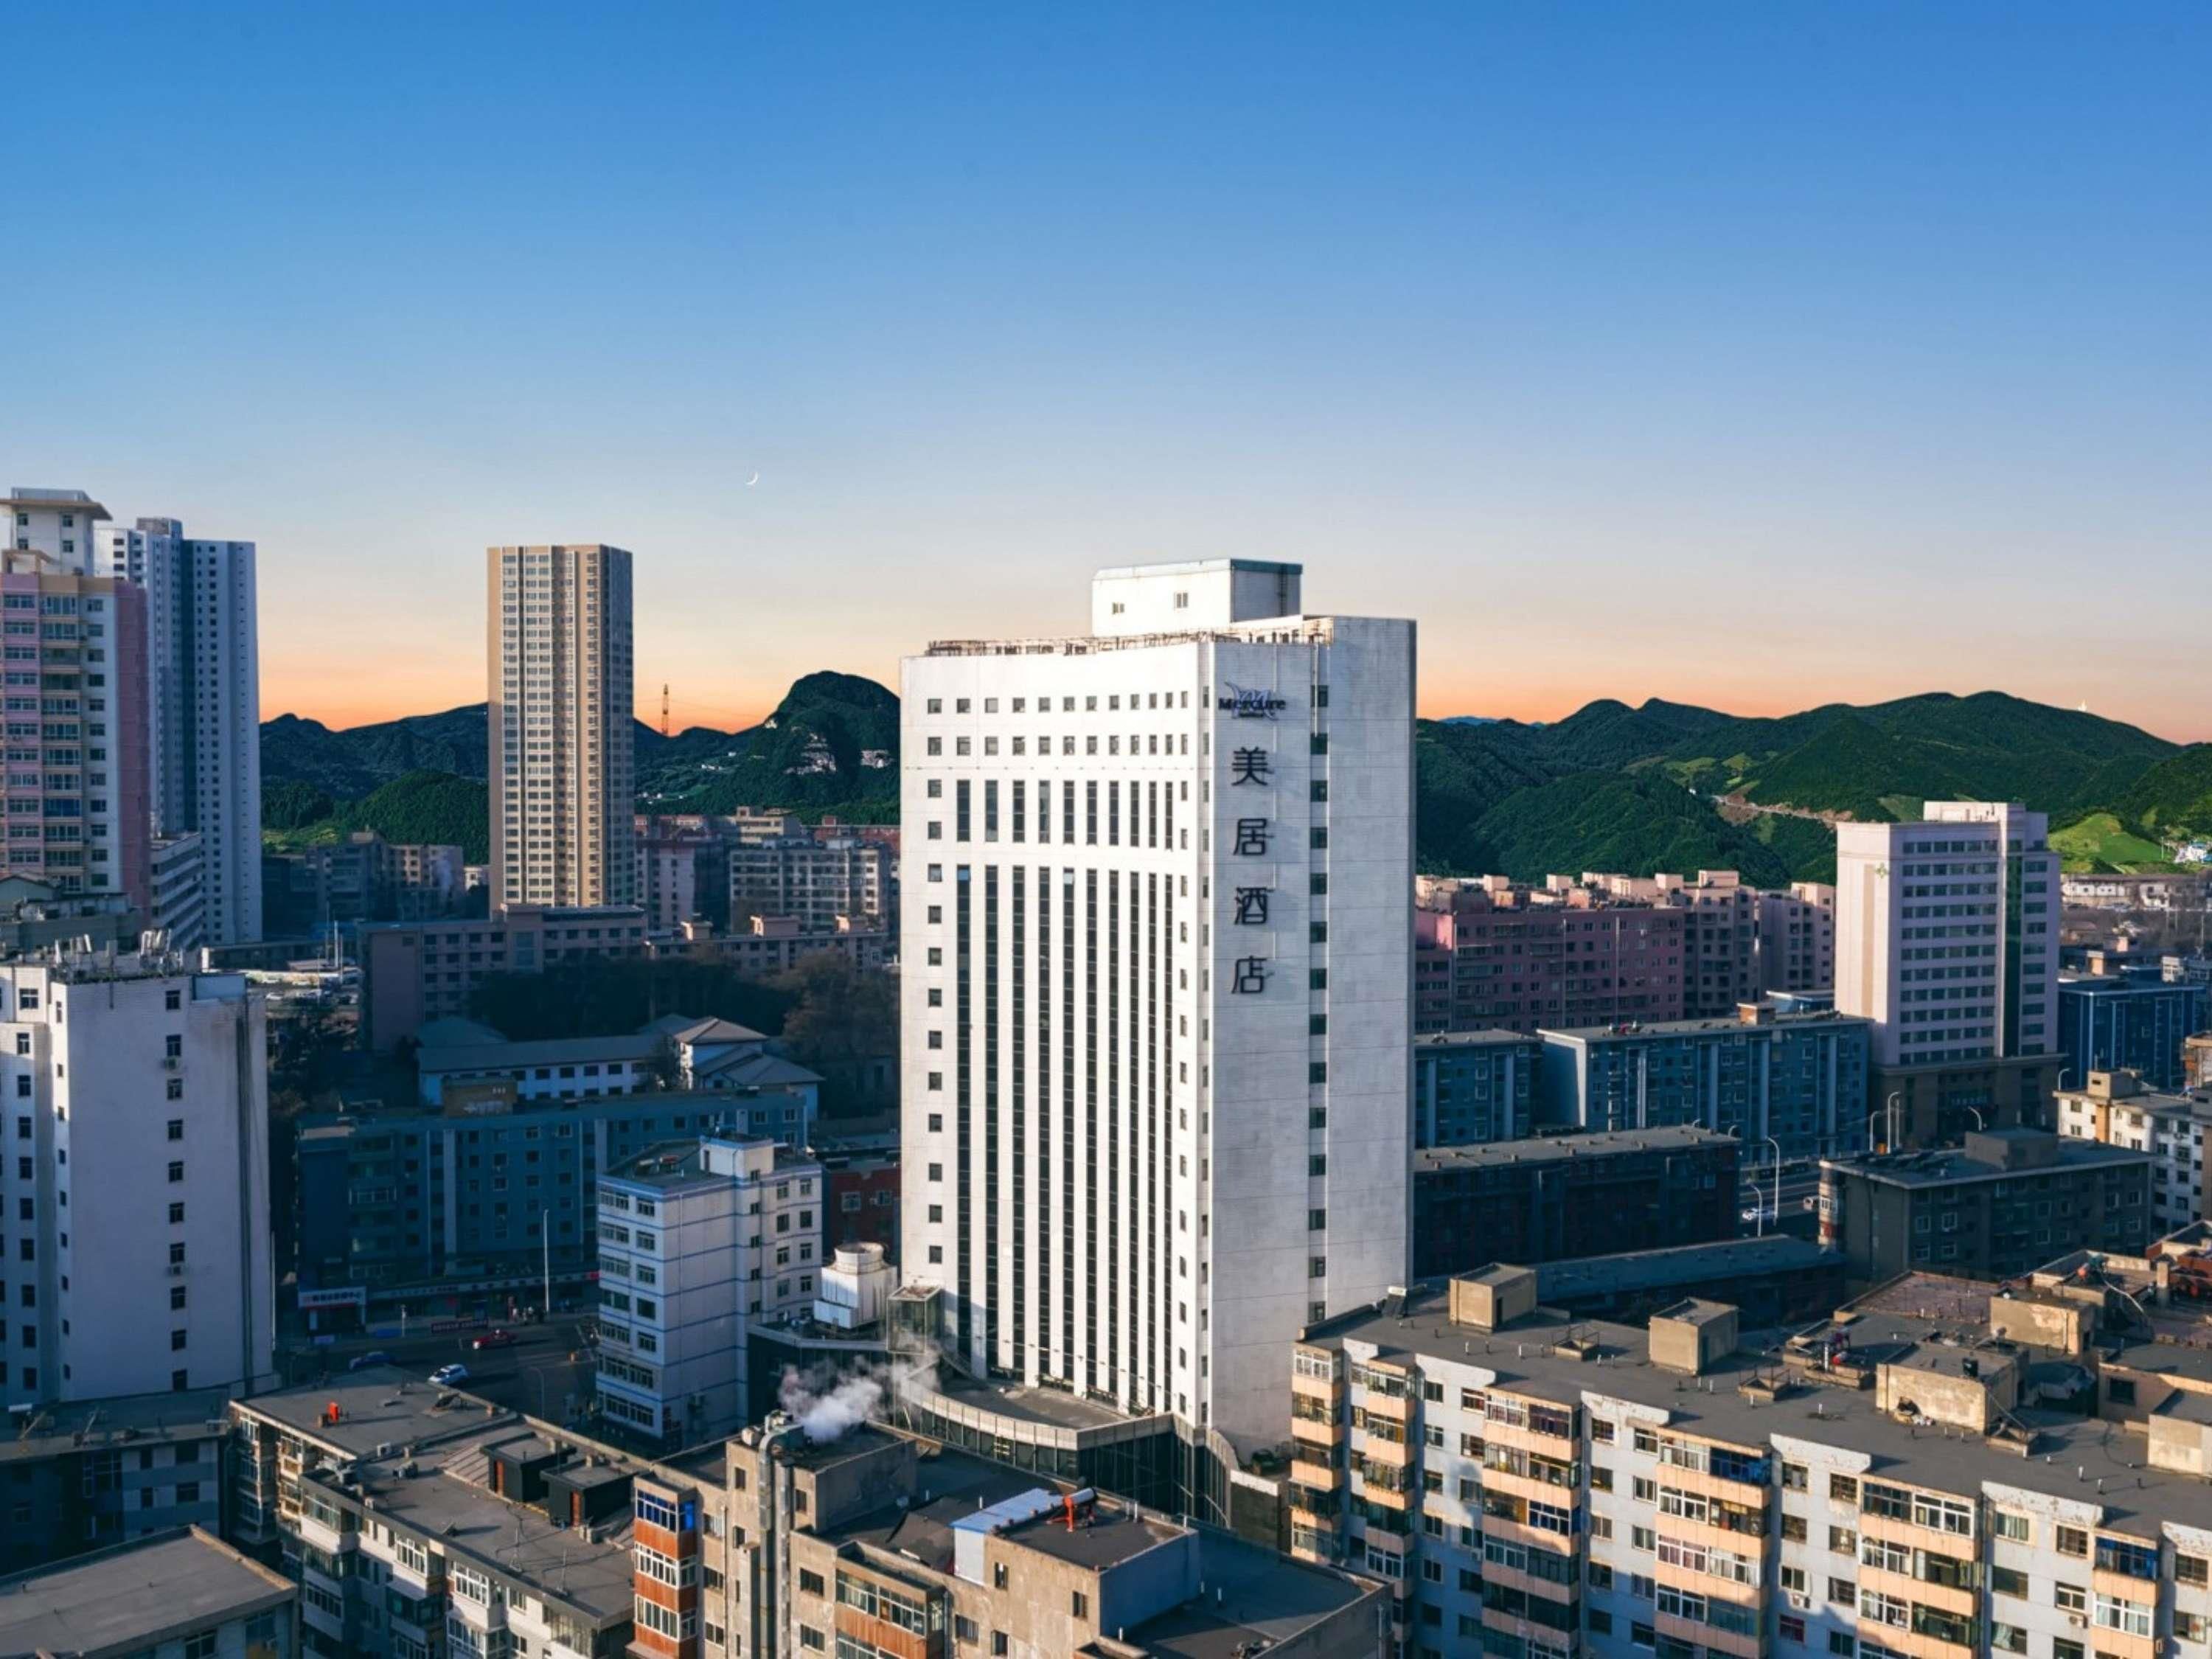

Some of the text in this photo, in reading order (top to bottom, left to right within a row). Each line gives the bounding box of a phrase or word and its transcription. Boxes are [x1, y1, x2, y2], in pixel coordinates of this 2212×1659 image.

[1218, 696, 1286, 710] Mercure
[1231, 746, 1268, 994] 美居酒店
